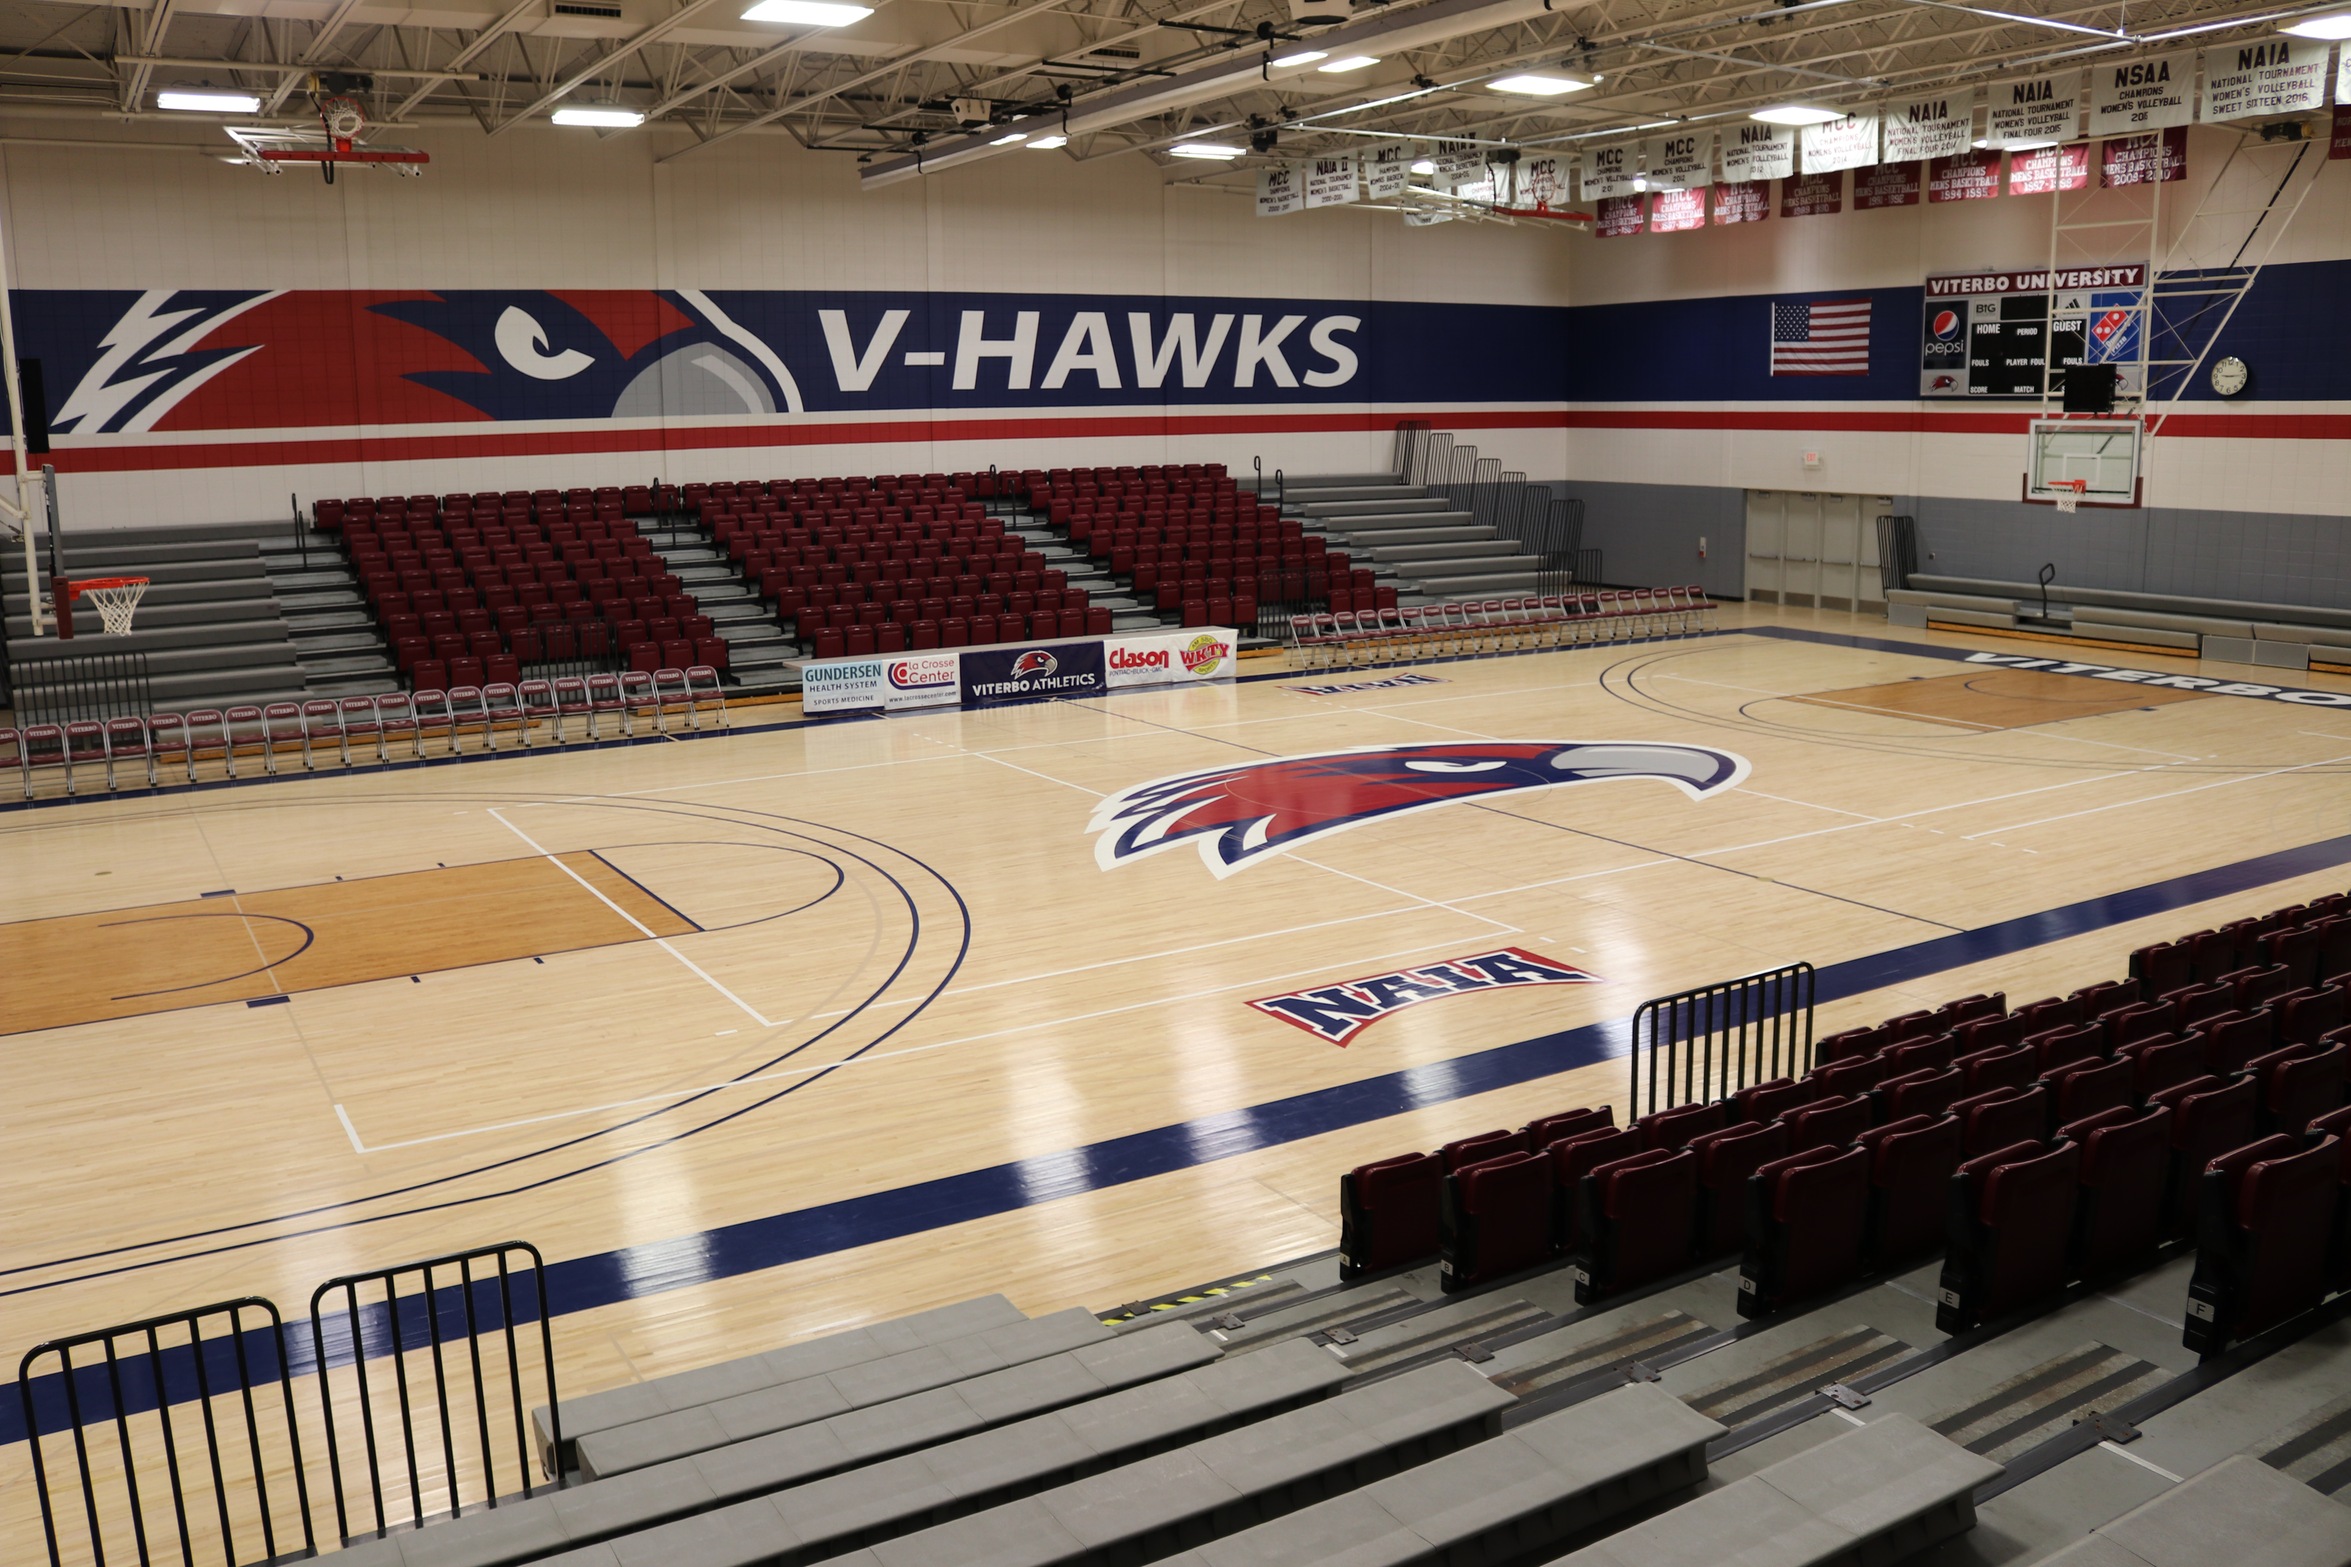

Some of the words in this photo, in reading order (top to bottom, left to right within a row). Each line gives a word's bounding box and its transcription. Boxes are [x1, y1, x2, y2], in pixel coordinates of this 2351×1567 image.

[2238, 42, 2289, 71] NAIA
[2115, 61, 2170, 88] NSAA
[2211, 74, 2252, 89] NATIONAL
[2259, 63, 2319, 80] TOURNAMENT
[2014, 80, 2053, 104] NAIA
[2120, 87, 2164, 100] CHAMPIONS
[2213, 87, 2250, 102] WOMEN'S
[2258, 79, 2314, 94] VOLLEYBALL
[1910, 100, 1947, 122] NAIA
[1992, 108, 2024, 118] NATIONAL
[2028, 99, 2074, 114] TOURNAMENT
[2101, 100, 2133, 114] WOMEN'S
[2138, 96, 2182, 109] VOLLEYBALL
[2213, 102, 2242, 114] SWEET
[2246, 95, 2281, 109] SIXTEEN
[2286, 93, 2308, 104] 2016
[1823, 112, 1856, 134] MCC
[2028, 112, 2070, 125] VOLLEYBALL
[1742, 125, 1772, 144] NAIA
[1888, 126, 1918, 136] NATIONAL
[1922, 118, 1969, 132] TOURNAMENT
[2003, 131, 2021, 139] FINAL
[2024, 128, 2042, 137] FOUR
[2045, 124, 2061, 134] 2015
[1922, 131, 1965, 142] VOLLEYBALL
[1666, 138, 1694, 158] MCC
[1752, 143, 1788, 152] TOURNAMENT
[1898, 147, 1917, 155] FINAL
[1921, 144, 1938, 153] FOUR
[1597, 148, 1623, 167] MCC
[1665, 156, 1694, 166] CHAMPIONS
[1316, 161, 1337, 176] NAIA
[1531, 159, 1556, 176] MCC
[1676, 162, 1706, 173] VOLLEYBALL
[1942, 166, 1986, 179] CHAMPIONS
[1269, 170, 1290, 187] MCC
[1930, 180, 1950, 190] MENS
[1951, 175, 1999, 188] BASKETBALL
[1931, 276, 2010, 295] VITERBO
[2016, 268, 2139, 290] UNIVERSITY
[1977, 324, 2000, 334] HOME
[2053, 321, 2082, 331] GUEST
[818, 309, 1361, 392] V-HAWKS
[1925, 340, 1964, 356] pepsi
[2006, 358, 2028, 366] PLAYER
[2063, 357, 2082, 365] FOULS
[1109, 648, 1169, 669] Clason
[1180, 643, 1229, 666] WKTY
[909, 661, 918, 670] la
[922, 659, 954, 669] Crosse
[805, 664, 881, 682] GUNDERSEN
[909, 670, 955, 683] Center
[1964, 652, 2351, 706] VITERBO
[810, 684, 841, 692] HEALTH
[844, 681, 877, 689] SYSTEM
[973, 680, 1030, 696] VITERBO
[1032, 673, 1095, 690] ATHLETICS
[453, 690, 476, 698] VITERBO
[814, 698, 839, 706] SPORTS
[841, 695, 874, 703] MEDICINE
[889, 691, 956, 703] www.lacrossecenter.com
[192, 714, 217, 722] VITERBO
[232, 710, 256, 718] VITERBO
[270, 707, 294, 715] VITERBO
[29, 729, 56, 737] VITERBO
[112, 722, 138, 730] VITERBO
[1250, 950, 1604, 1042] NAIA
[1579, 1272, 1586, 1281] C
[1744, 1280, 1750, 1289] D
[1946, 1293, 1953, 1304] E
[2196, 1304, 2206, 1315] F
